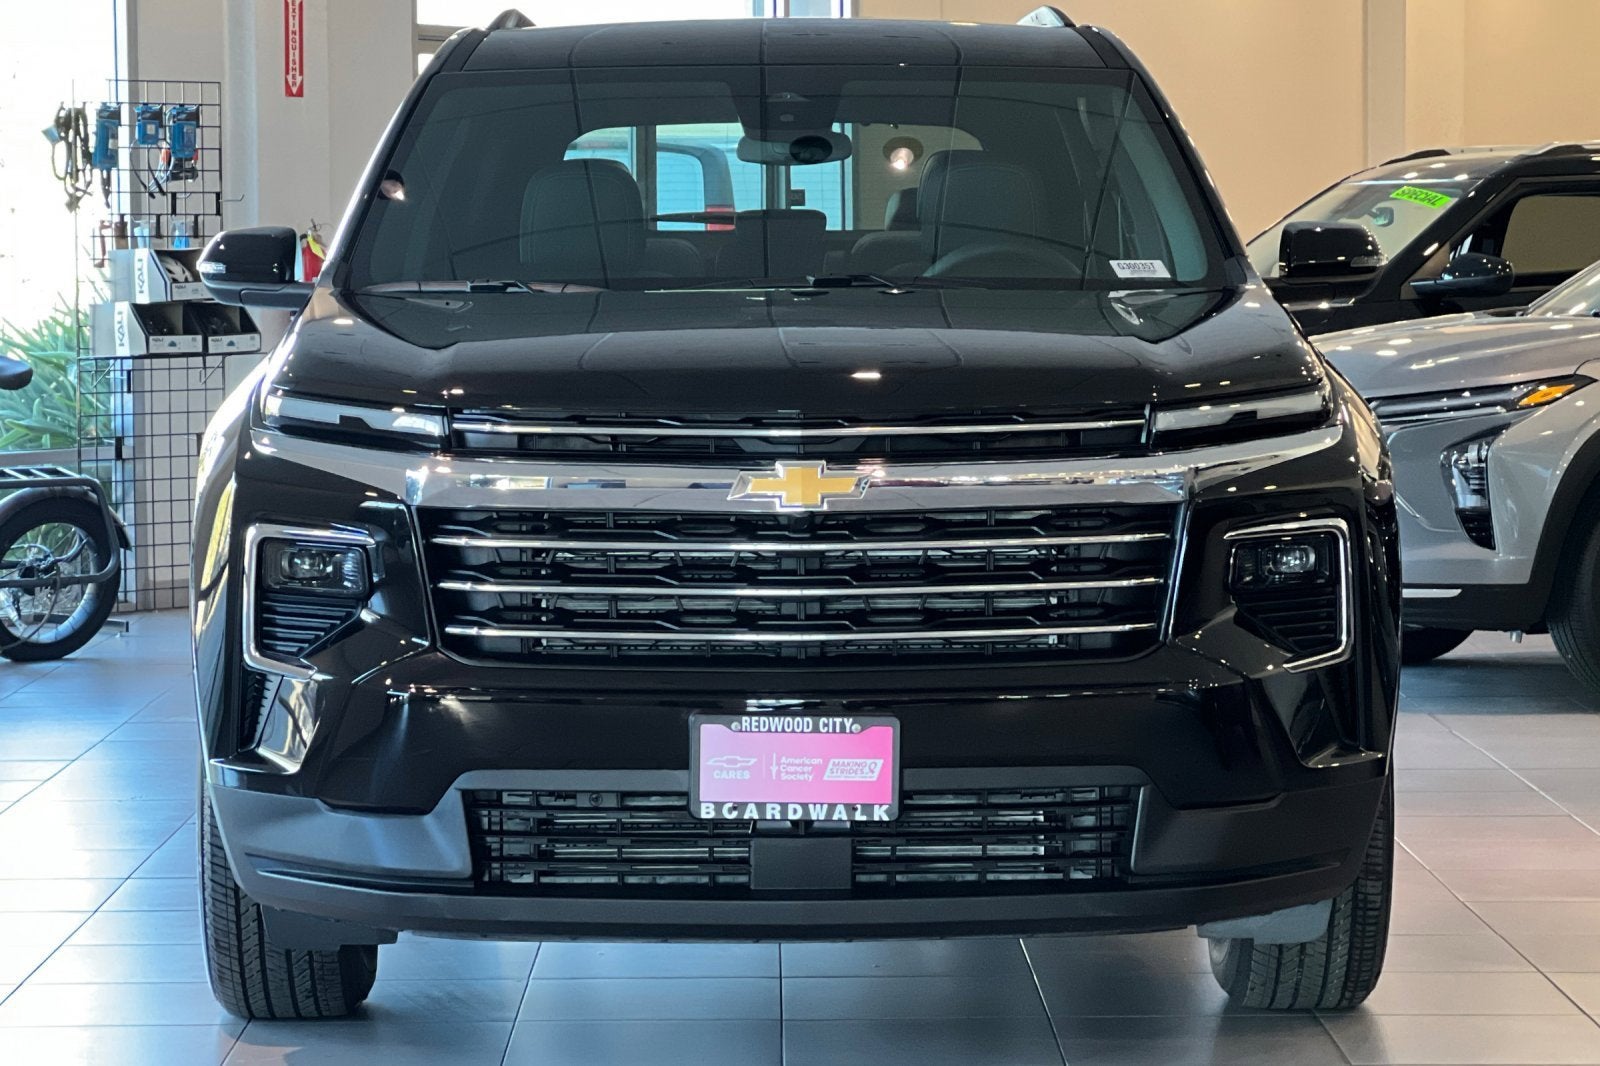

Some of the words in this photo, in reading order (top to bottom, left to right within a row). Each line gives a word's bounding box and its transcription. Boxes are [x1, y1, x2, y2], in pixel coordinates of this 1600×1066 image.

[1396, 187, 1442, 206] SPECIAL
[137, 258, 145, 294] KALI
[117, 311, 125, 347] KALI
[741, 716, 813, 732] REDWOOD
[819, 717, 853, 733] CITY
[780, 756, 823, 765] American
[832, 760, 868, 768] MAKING
[713, 769, 751, 779] CARES
[780, 764, 813, 773] Cancer
[780, 772, 814, 782] Society
[700, 802, 890, 821] BOARDWALK
